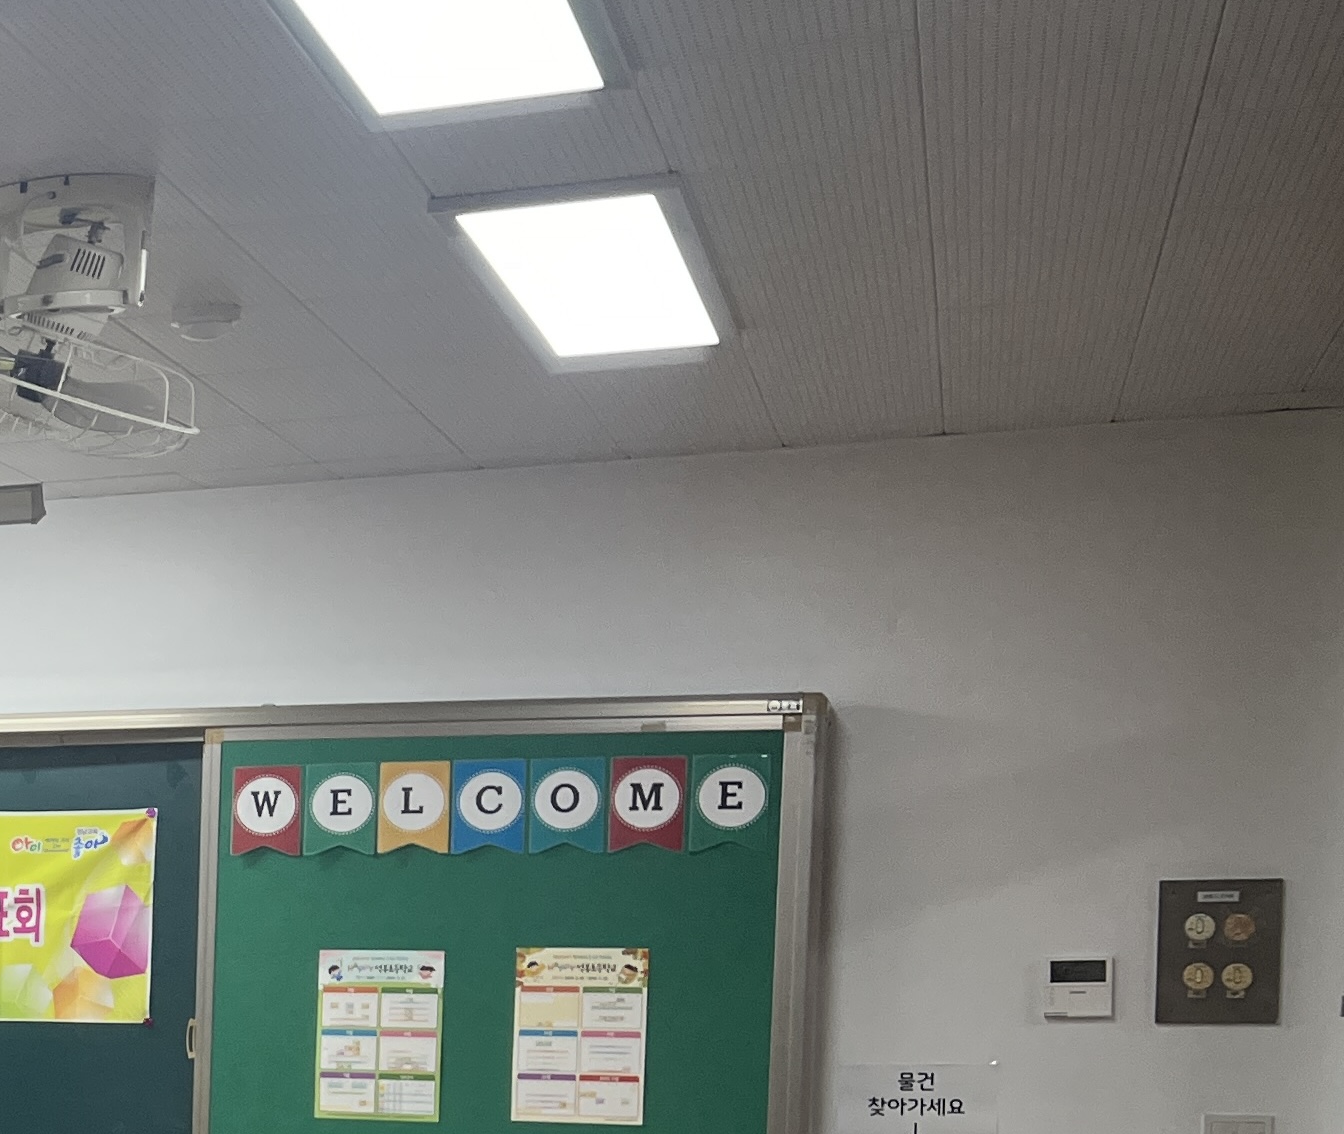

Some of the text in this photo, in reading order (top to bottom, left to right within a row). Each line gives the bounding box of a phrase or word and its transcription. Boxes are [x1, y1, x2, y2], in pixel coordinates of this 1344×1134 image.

[250, 779, 744, 819] WELCOME
[898, 1072, 935, 1092] 물건
[868, 1097, 965, 1117] 찾아가세요
